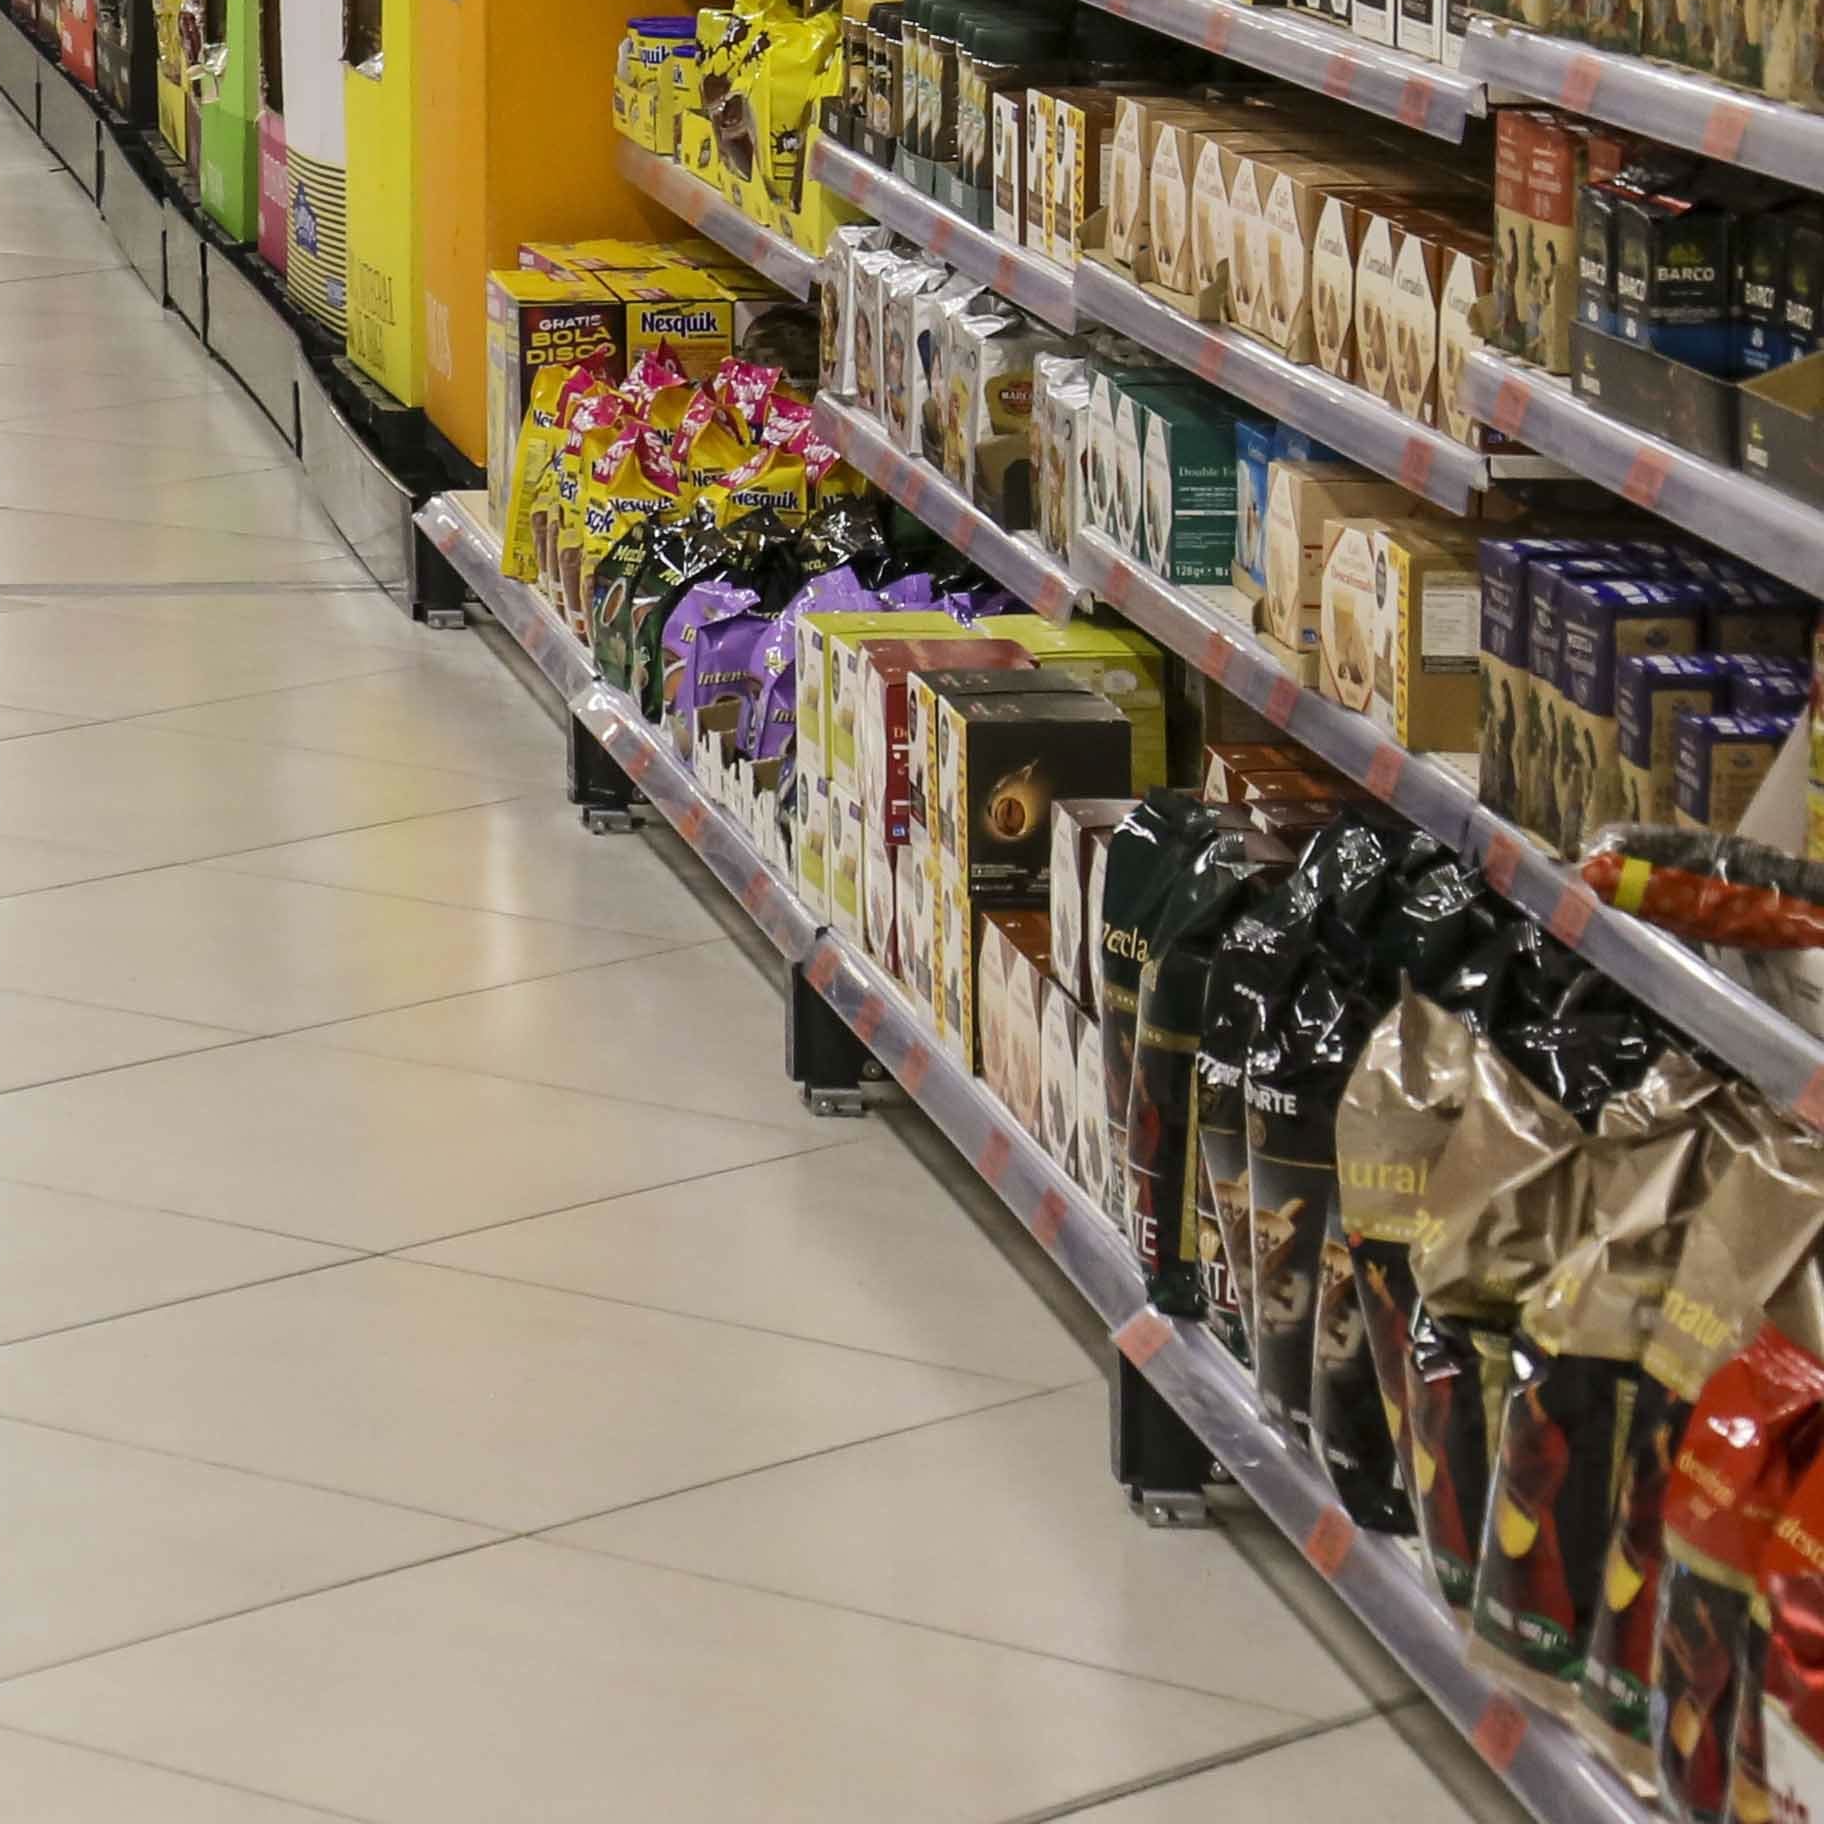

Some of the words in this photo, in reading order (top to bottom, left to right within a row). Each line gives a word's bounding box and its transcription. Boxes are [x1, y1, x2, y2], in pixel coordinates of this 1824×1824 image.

[1045, 107, 1055, 242] GRATIS
[1073, 119, 1084, 225] RATIS
[1658, 266, 1716, 282] BARCO
[538, 314, 603, 332] GRATIS
[640, 311, 718, 339] Nesquik
[530, 327, 613, 348] BOLA
[525, 342, 617, 365] DISCO
[1001, 389, 1031, 401] MARC
[731, 490, 799, 510] Nesquik
[1348, 1160, 1430, 1195] ural
[1661, 1287, 1744, 1349] natur
